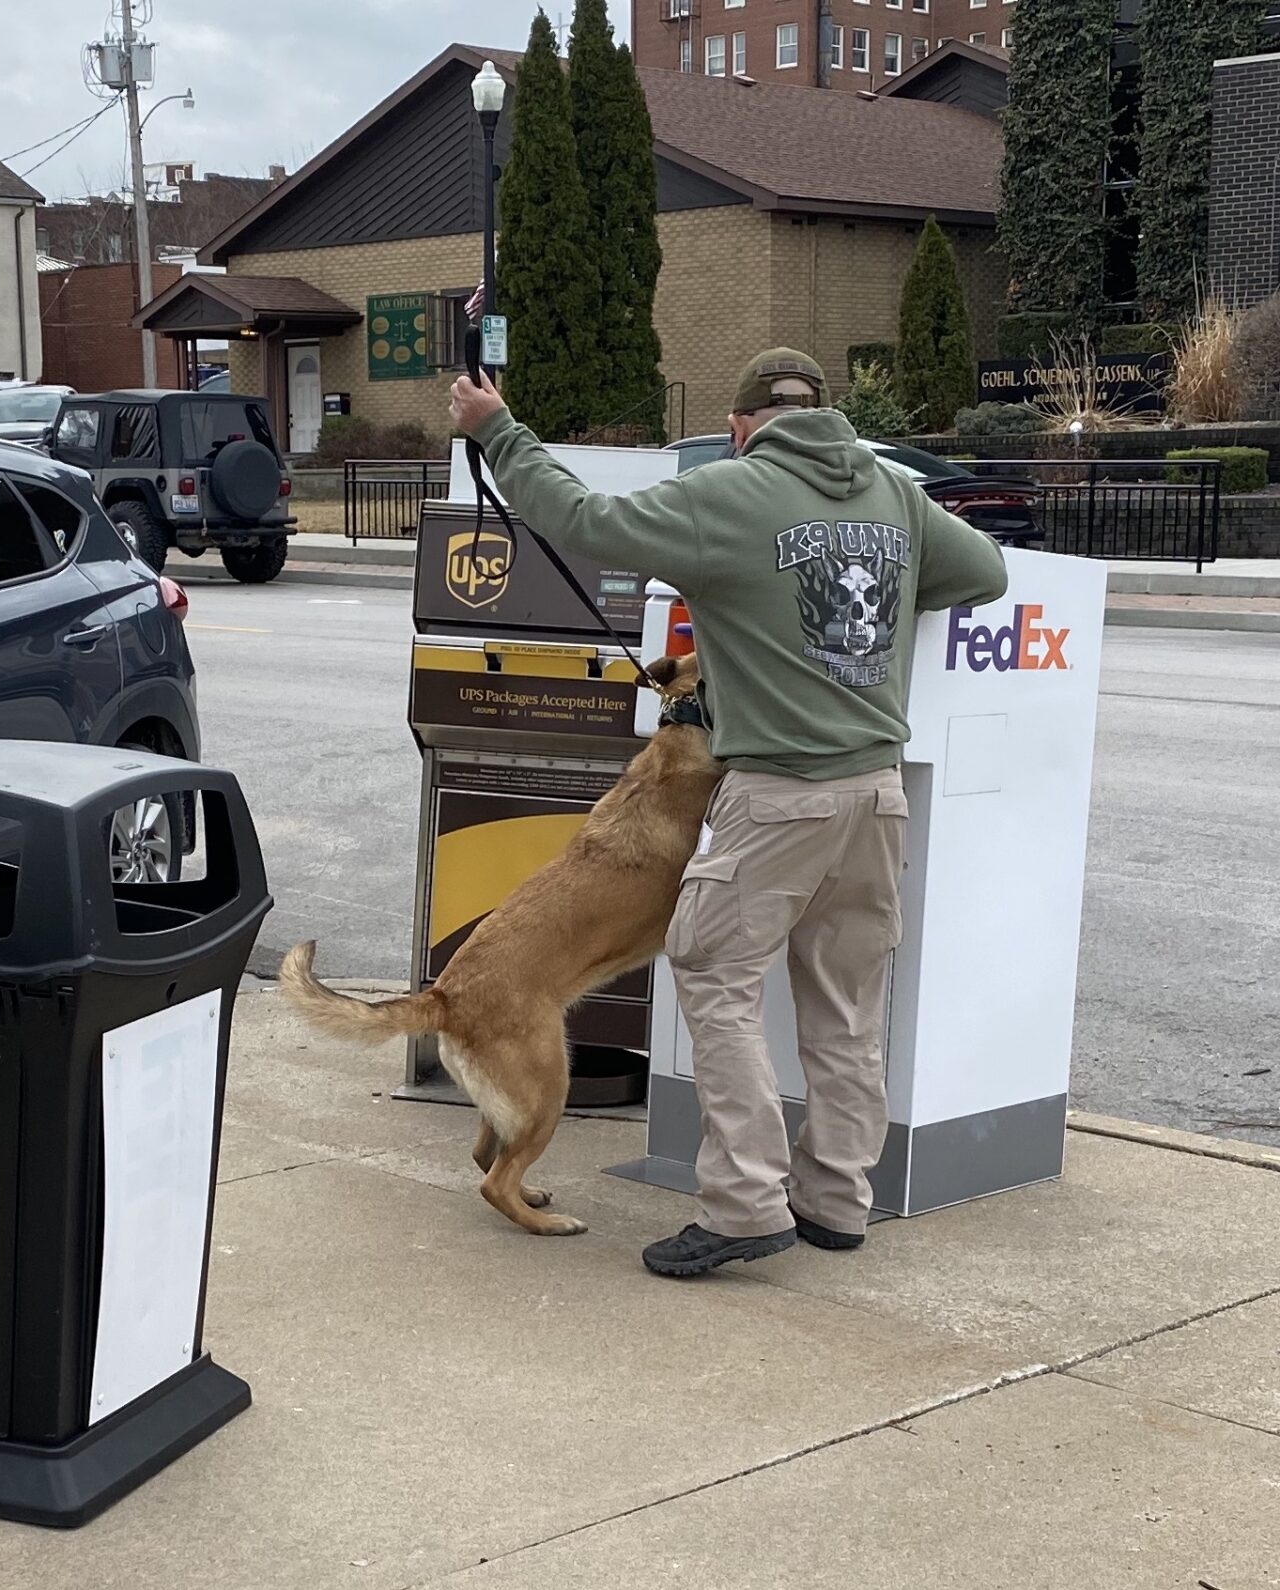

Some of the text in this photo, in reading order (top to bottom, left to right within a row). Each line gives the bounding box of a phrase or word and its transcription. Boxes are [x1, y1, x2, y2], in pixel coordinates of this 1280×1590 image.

[373, 298, 391, 312] LAW
[484, 318, 491, 332] 3
[776, 520, 912, 570] K9 UNIT
[450, 554, 506, 596] ups
[945, 604, 1070, 673] FedEx
[827, 663, 889, 688] POLICE
[459, 687, 627, 711] UPS Packages Accepted Here
[472, 706, 498, 715] GROUND
[531, 710, 576, 720] INTERNATIONAL
